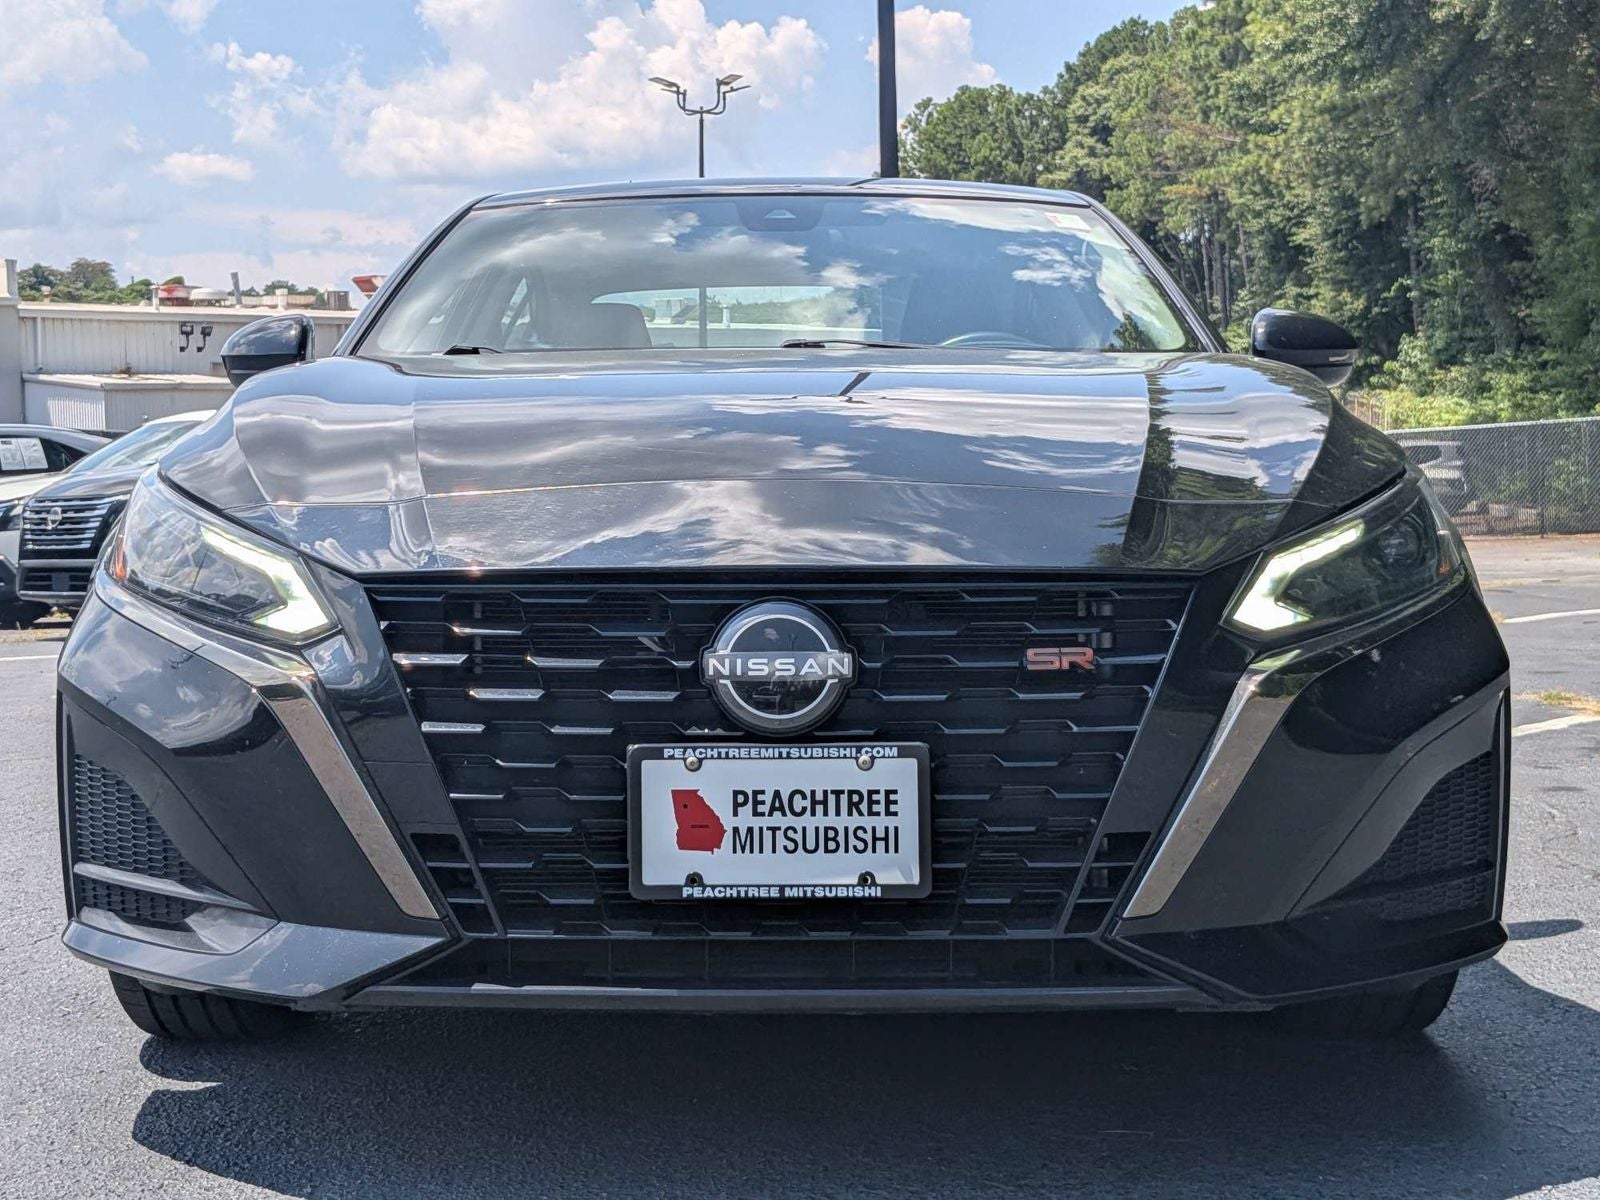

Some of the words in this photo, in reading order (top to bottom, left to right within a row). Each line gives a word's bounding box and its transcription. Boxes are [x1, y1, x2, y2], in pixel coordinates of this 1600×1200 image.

[708, 657, 849, 676] NISSAN
[1026, 647, 1095, 670] SR
[663, 747, 898, 758] PEACHTREEMITSUBISHI.COM
[732, 789, 899, 817] PEACHTREE
[732, 825, 899, 854] MITSUBISHI
[682, 886, 780, 897] PEACHTREE
[784, 886, 882, 897] MITSUBISHI
